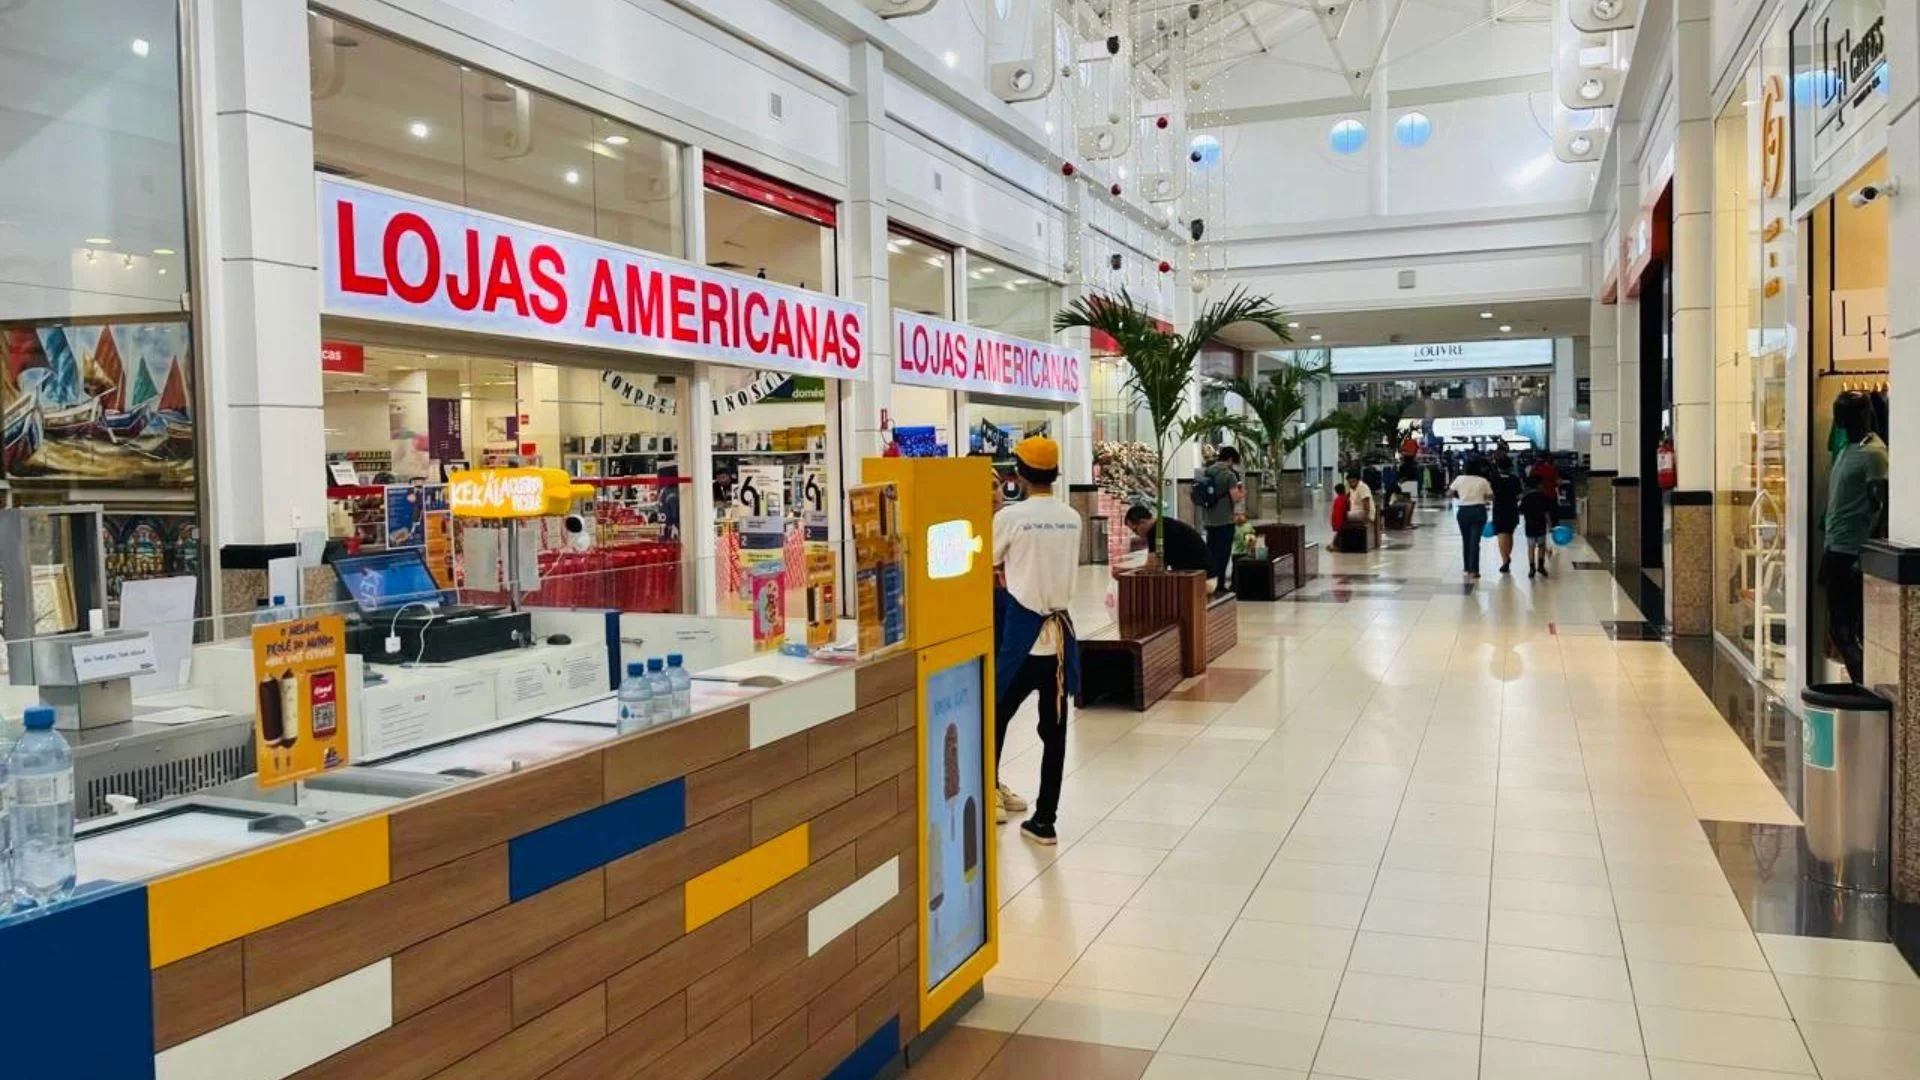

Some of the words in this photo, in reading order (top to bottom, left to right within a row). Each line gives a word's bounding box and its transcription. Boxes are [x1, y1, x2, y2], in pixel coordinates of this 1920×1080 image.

[337, 200, 567, 324] LOJAS
[585, 258, 862, 370] AMERICANAS
[900, 322, 968, 379] LOJAS
[974, 338, 1080, 394] AMERICANAS
[1414, 344, 1463, 357] LOUVRE
